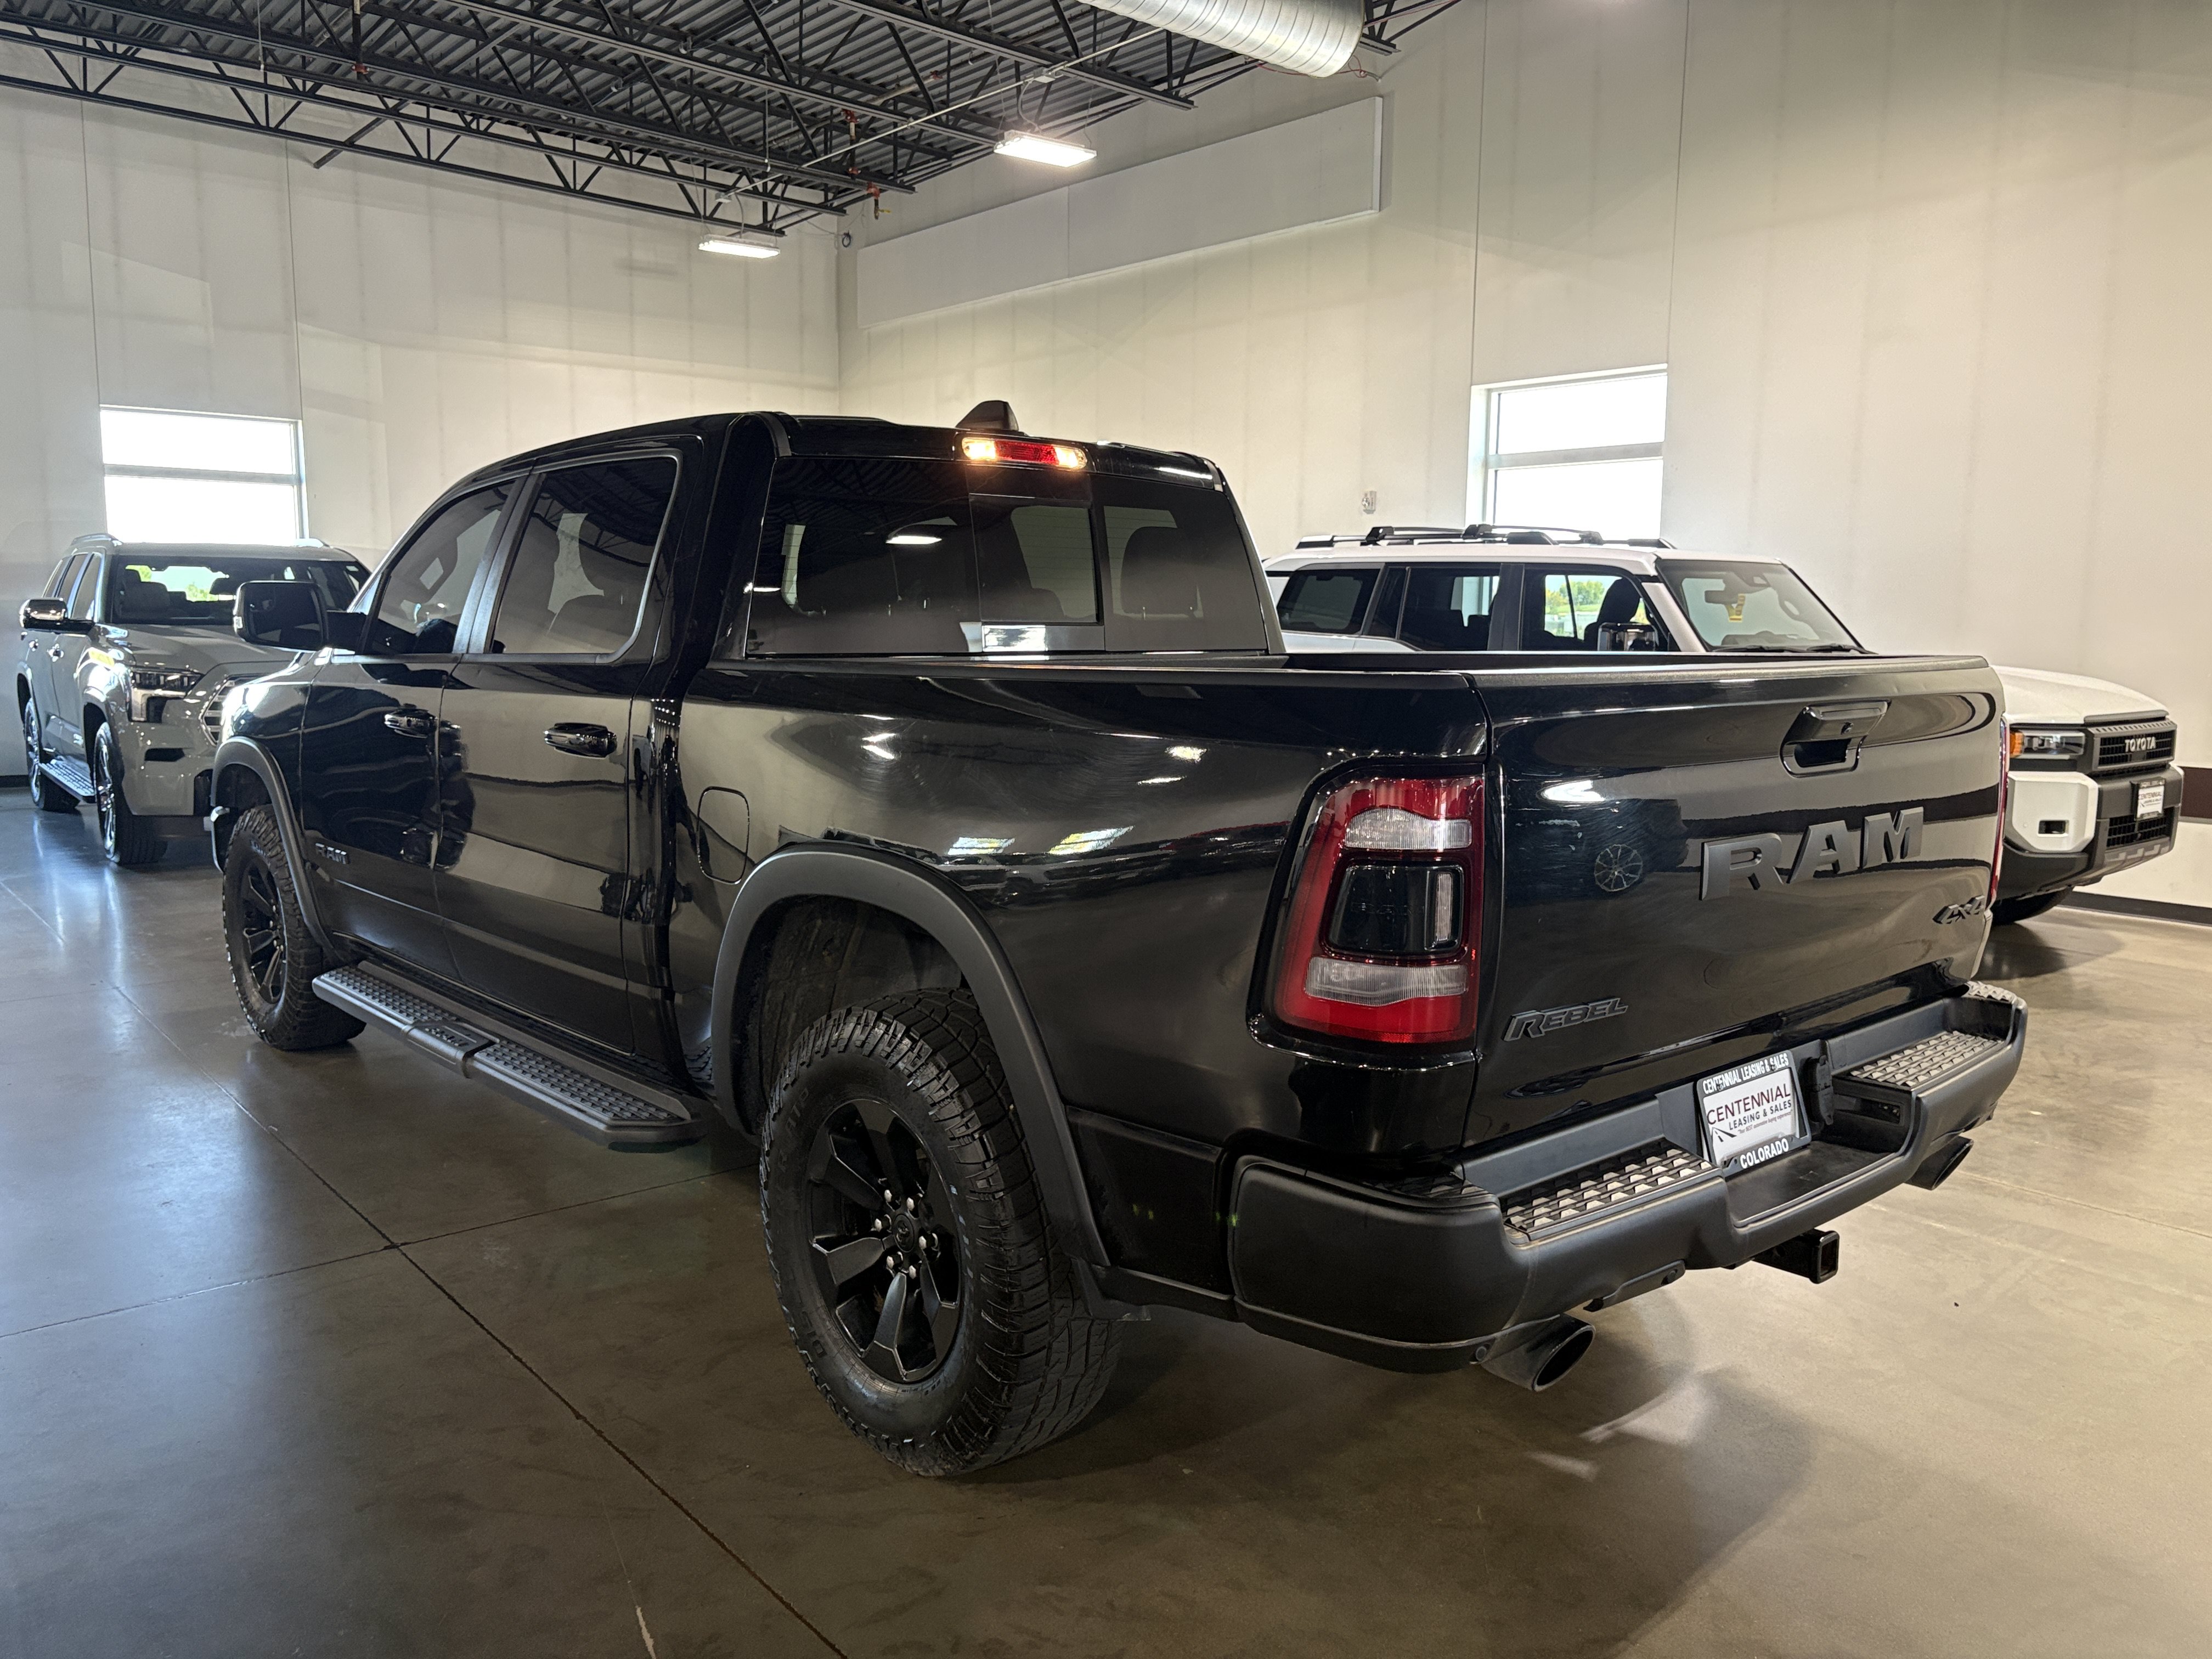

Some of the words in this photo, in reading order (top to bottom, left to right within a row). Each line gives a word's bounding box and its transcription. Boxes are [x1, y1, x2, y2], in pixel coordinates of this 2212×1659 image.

[2125, 737, 2156, 752] TOYOTA
[315, 843, 349, 865] RAM
[1700, 806, 1923, 900] RAM
[1703, 1069, 1741, 1094] CENTENNIAL
[1741, 1060, 1765, 1081] LEASING
[1764, 1059, 1770, 1070] &
[1770, 1053, 1788, 1071] SALES
[1707, 1084, 1791, 1125] CENTENNIAL
[1729, 1111, 1760, 1130] LEASING
[1763, 1109, 1767, 1117] &
[1770, 1099, 1791, 1114] SALES
[1740, 1138, 1789, 1169] COLORADO
